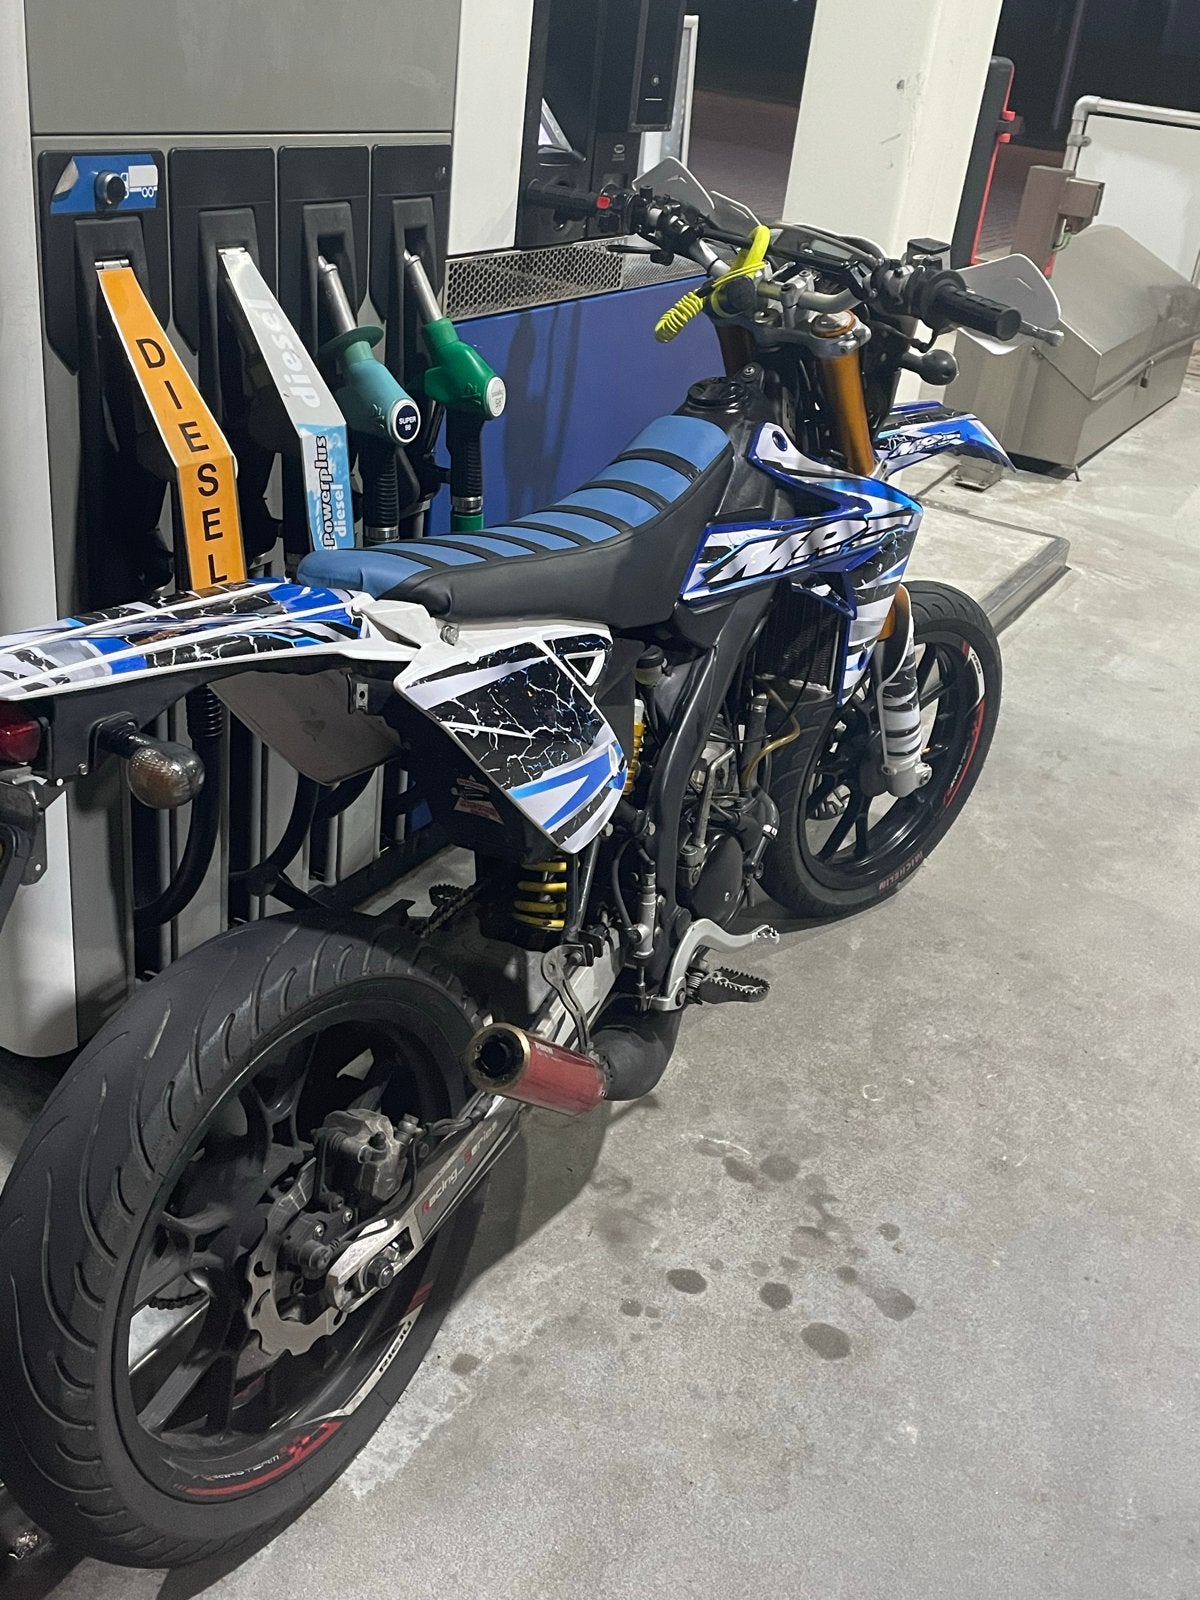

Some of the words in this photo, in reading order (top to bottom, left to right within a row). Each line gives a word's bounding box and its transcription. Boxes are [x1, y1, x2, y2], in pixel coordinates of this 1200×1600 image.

[244, 299, 321, 408] diesel
[398, 415, 417, 425] SUPER
[136, 338, 228, 585] DIESEL
[330, 483, 347, 538] diesel
[879, 850, 924, 890] MICHELIN
